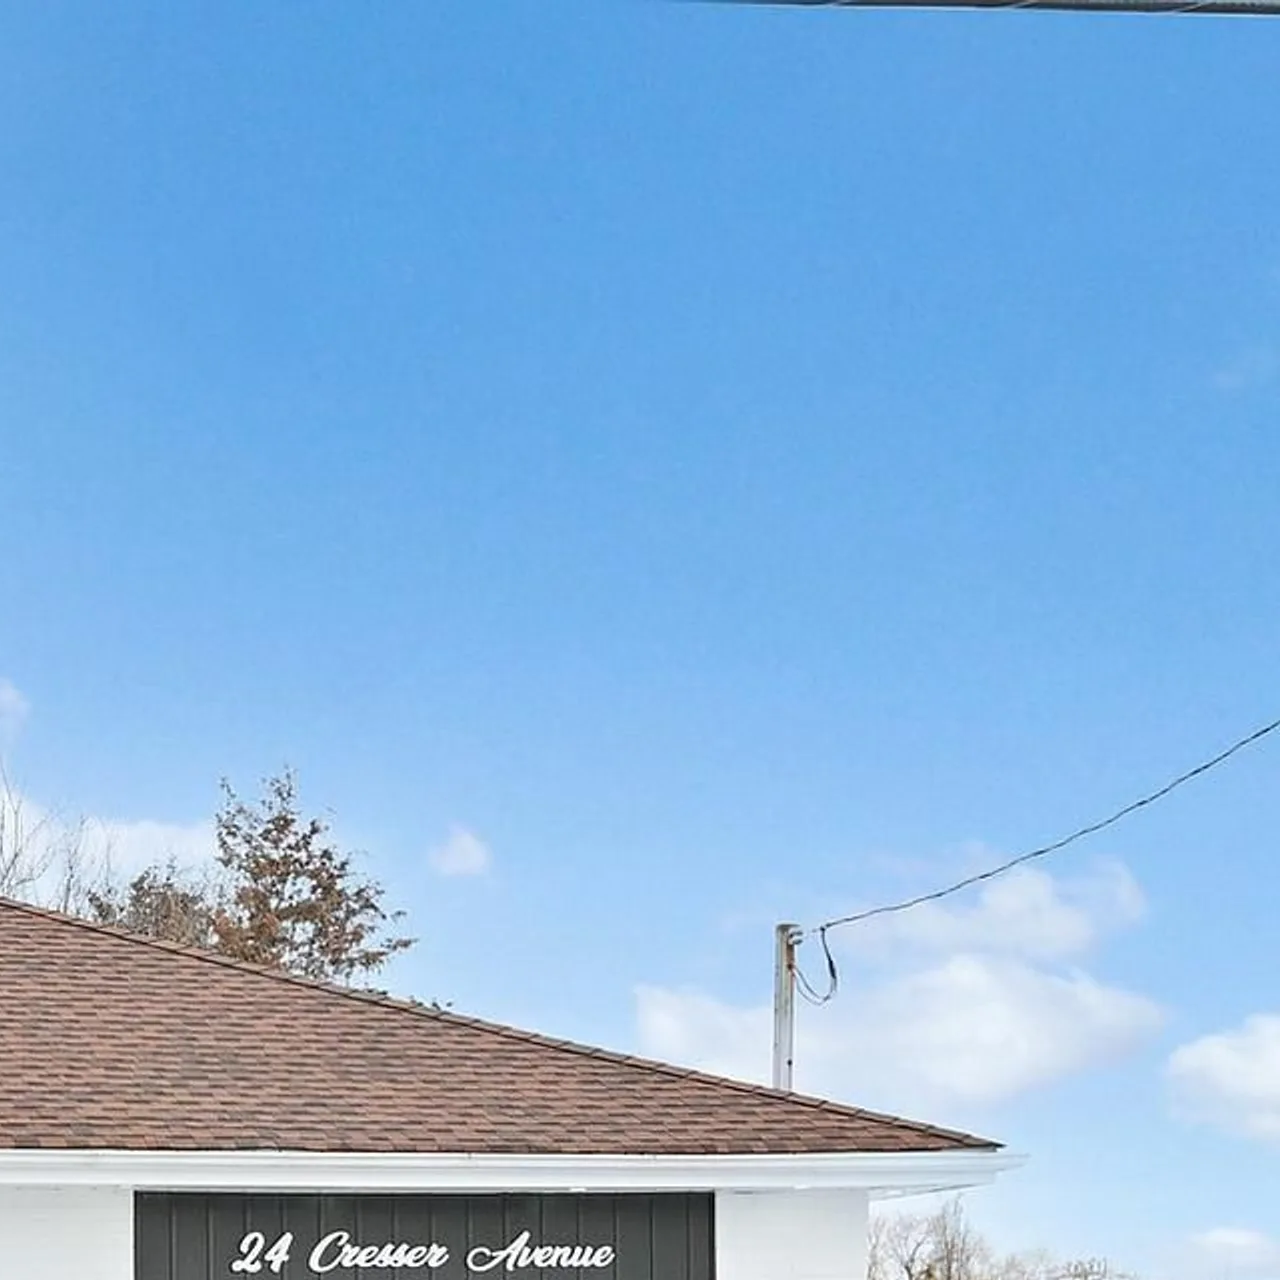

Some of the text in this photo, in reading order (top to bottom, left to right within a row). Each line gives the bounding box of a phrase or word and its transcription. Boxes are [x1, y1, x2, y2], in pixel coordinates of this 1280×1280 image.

[232, 1230, 615, 1274] 24 Cresser Avenue
